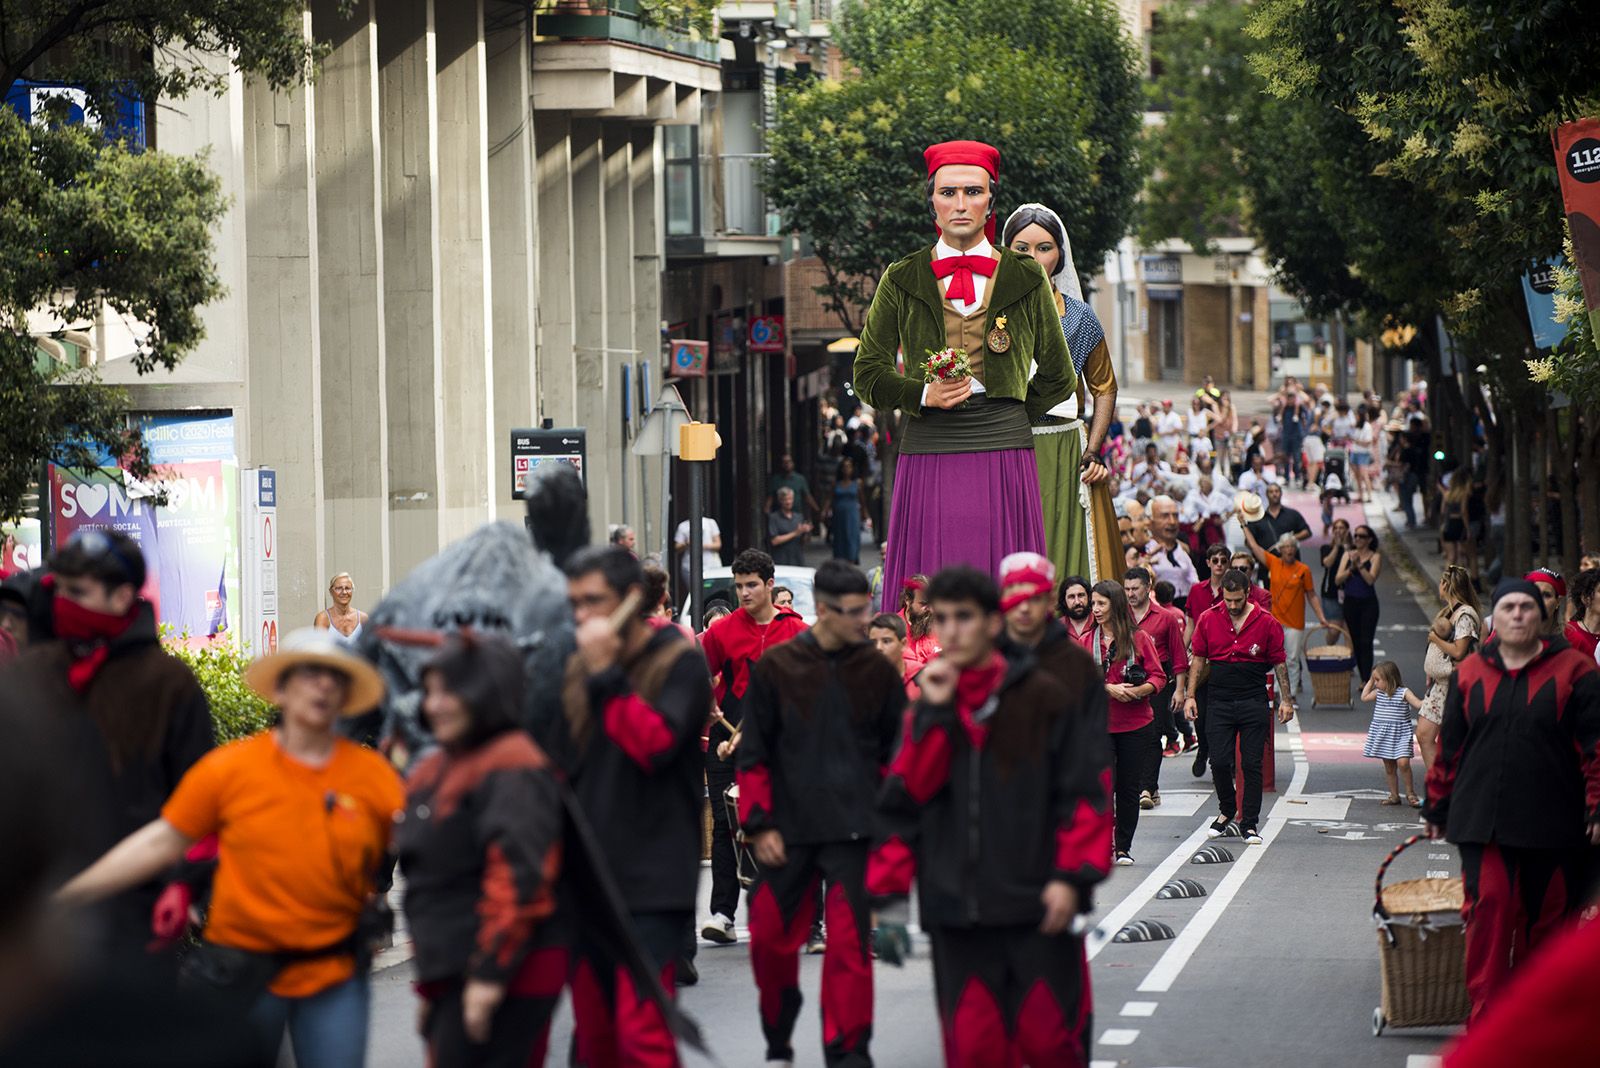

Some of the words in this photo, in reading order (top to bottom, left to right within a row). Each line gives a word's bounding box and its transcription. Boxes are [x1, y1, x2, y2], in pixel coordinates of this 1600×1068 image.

[1571, 146, 1600, 168] 112
[517, 438, 530, 446] BUS
[113, 522, 141, 531] SOCIAL
